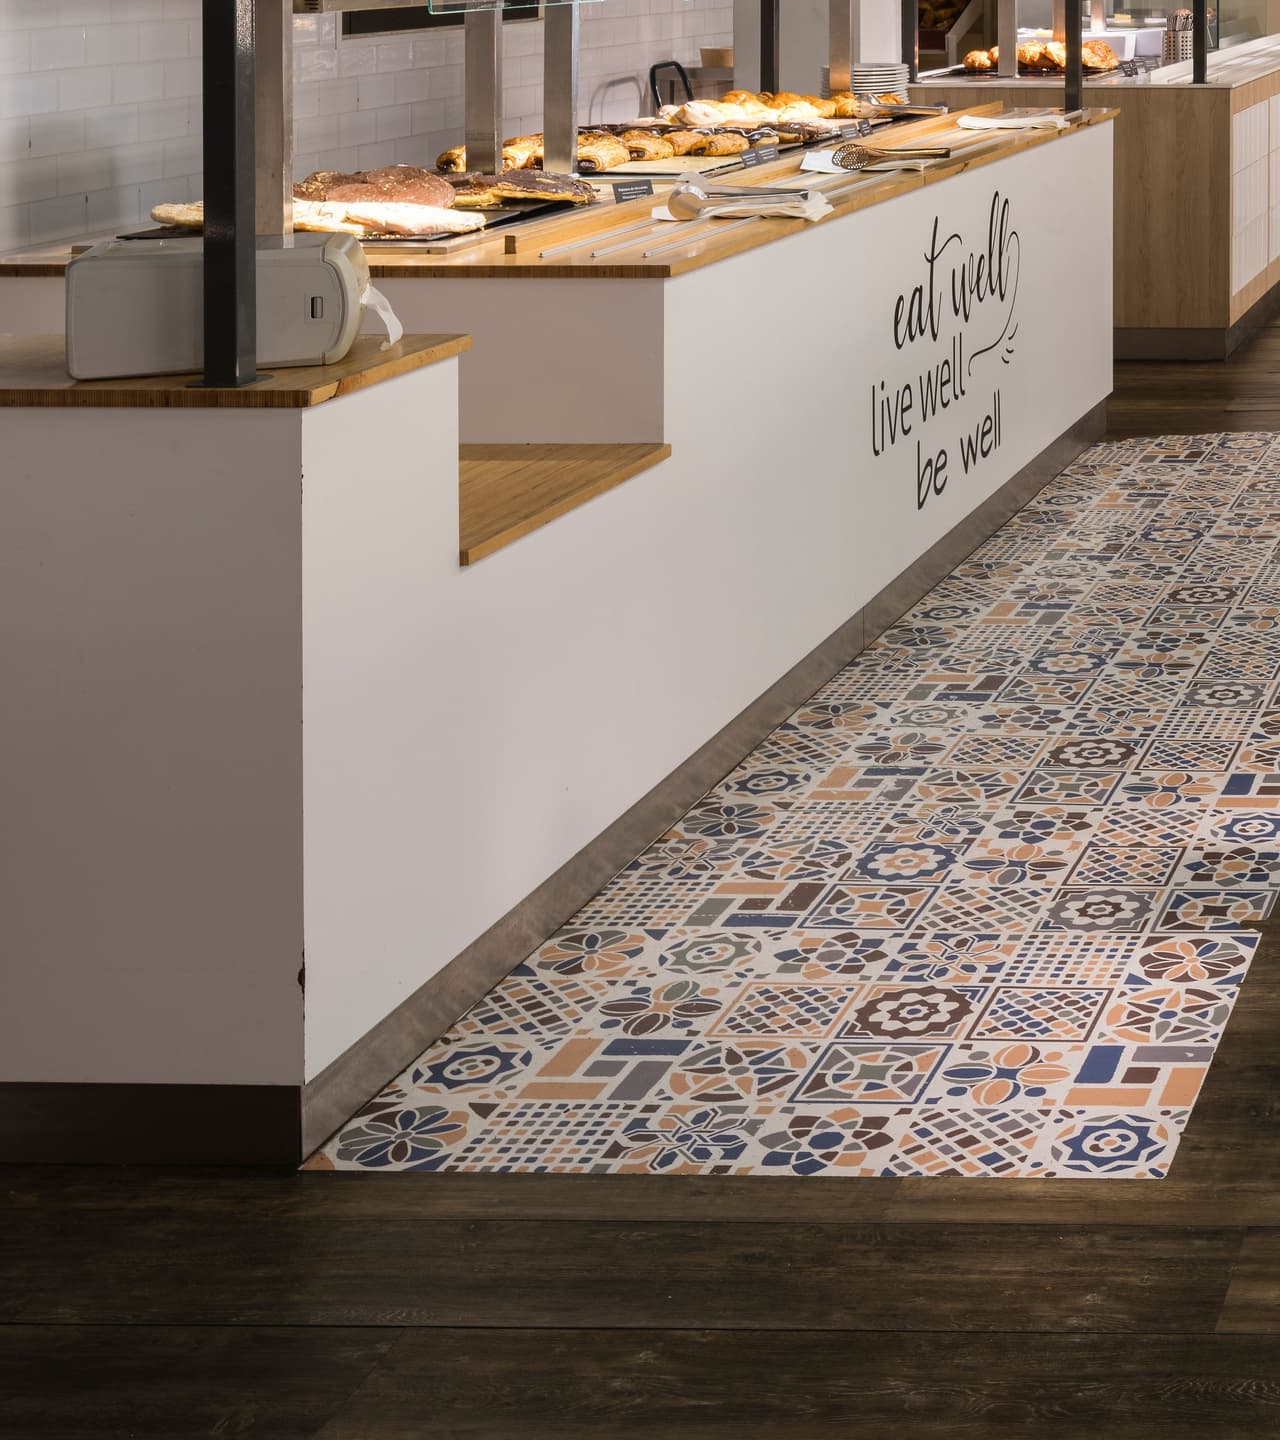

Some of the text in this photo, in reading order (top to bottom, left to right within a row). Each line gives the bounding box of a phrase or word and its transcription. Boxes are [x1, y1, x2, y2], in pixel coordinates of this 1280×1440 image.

[893, 191, 1020, 350] eat well
[872, 331, 966, 457] live well
[916, 388, 1001, 511] be well
